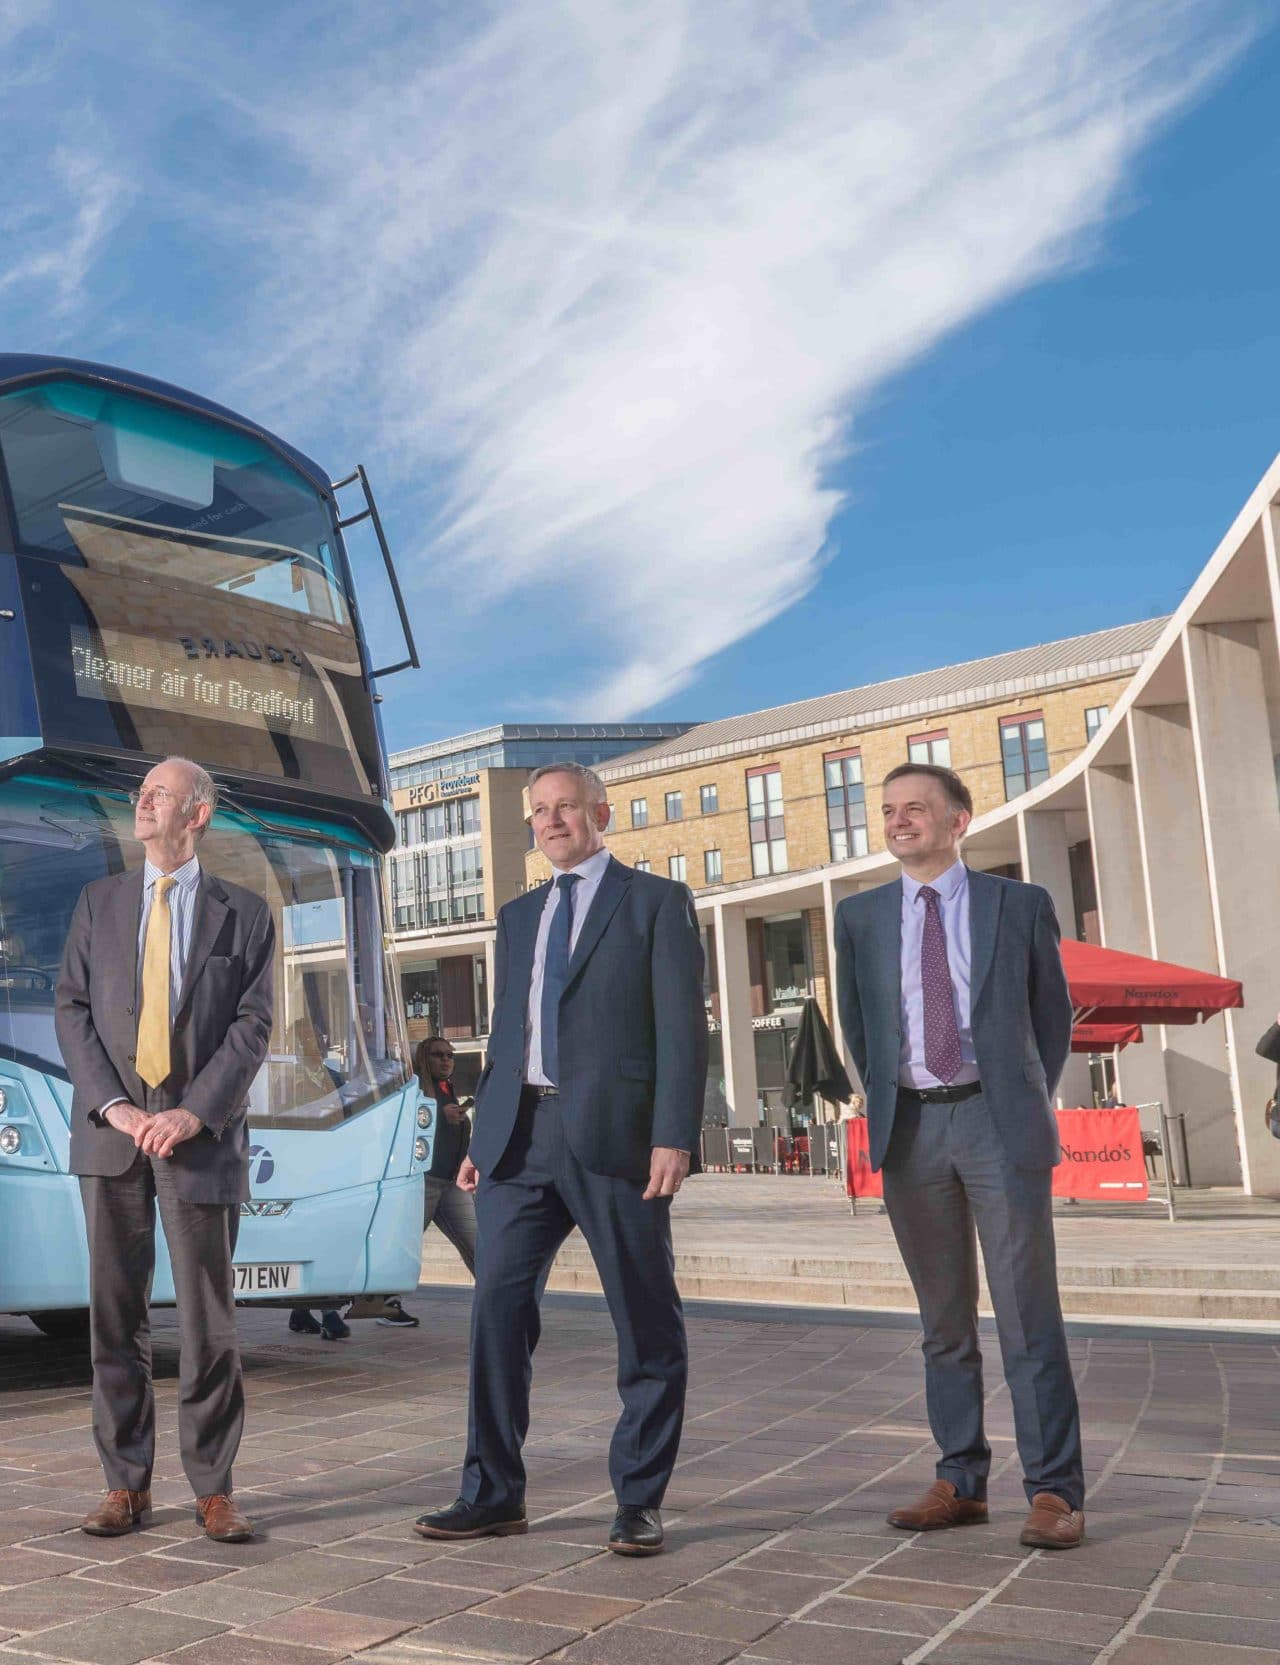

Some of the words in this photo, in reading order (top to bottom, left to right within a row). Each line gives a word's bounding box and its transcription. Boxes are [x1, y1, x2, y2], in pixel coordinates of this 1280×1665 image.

[71, 645, 155, 690] Cleaner
[160, 668, 189, 698] air
[192, 672, 223, 705] for
[228, 679, 315, 725] Bradford
[409, 784, 435, 805] PFG
[440, 773, 481, 791] Provident
[1124, 988, 1180, 999] Nando's
[751, 1017, 783, 1028] COFFEE
[1060, 1143, 1132, 1162] Nando's
[257, 1266, 290, 1289] ENV
